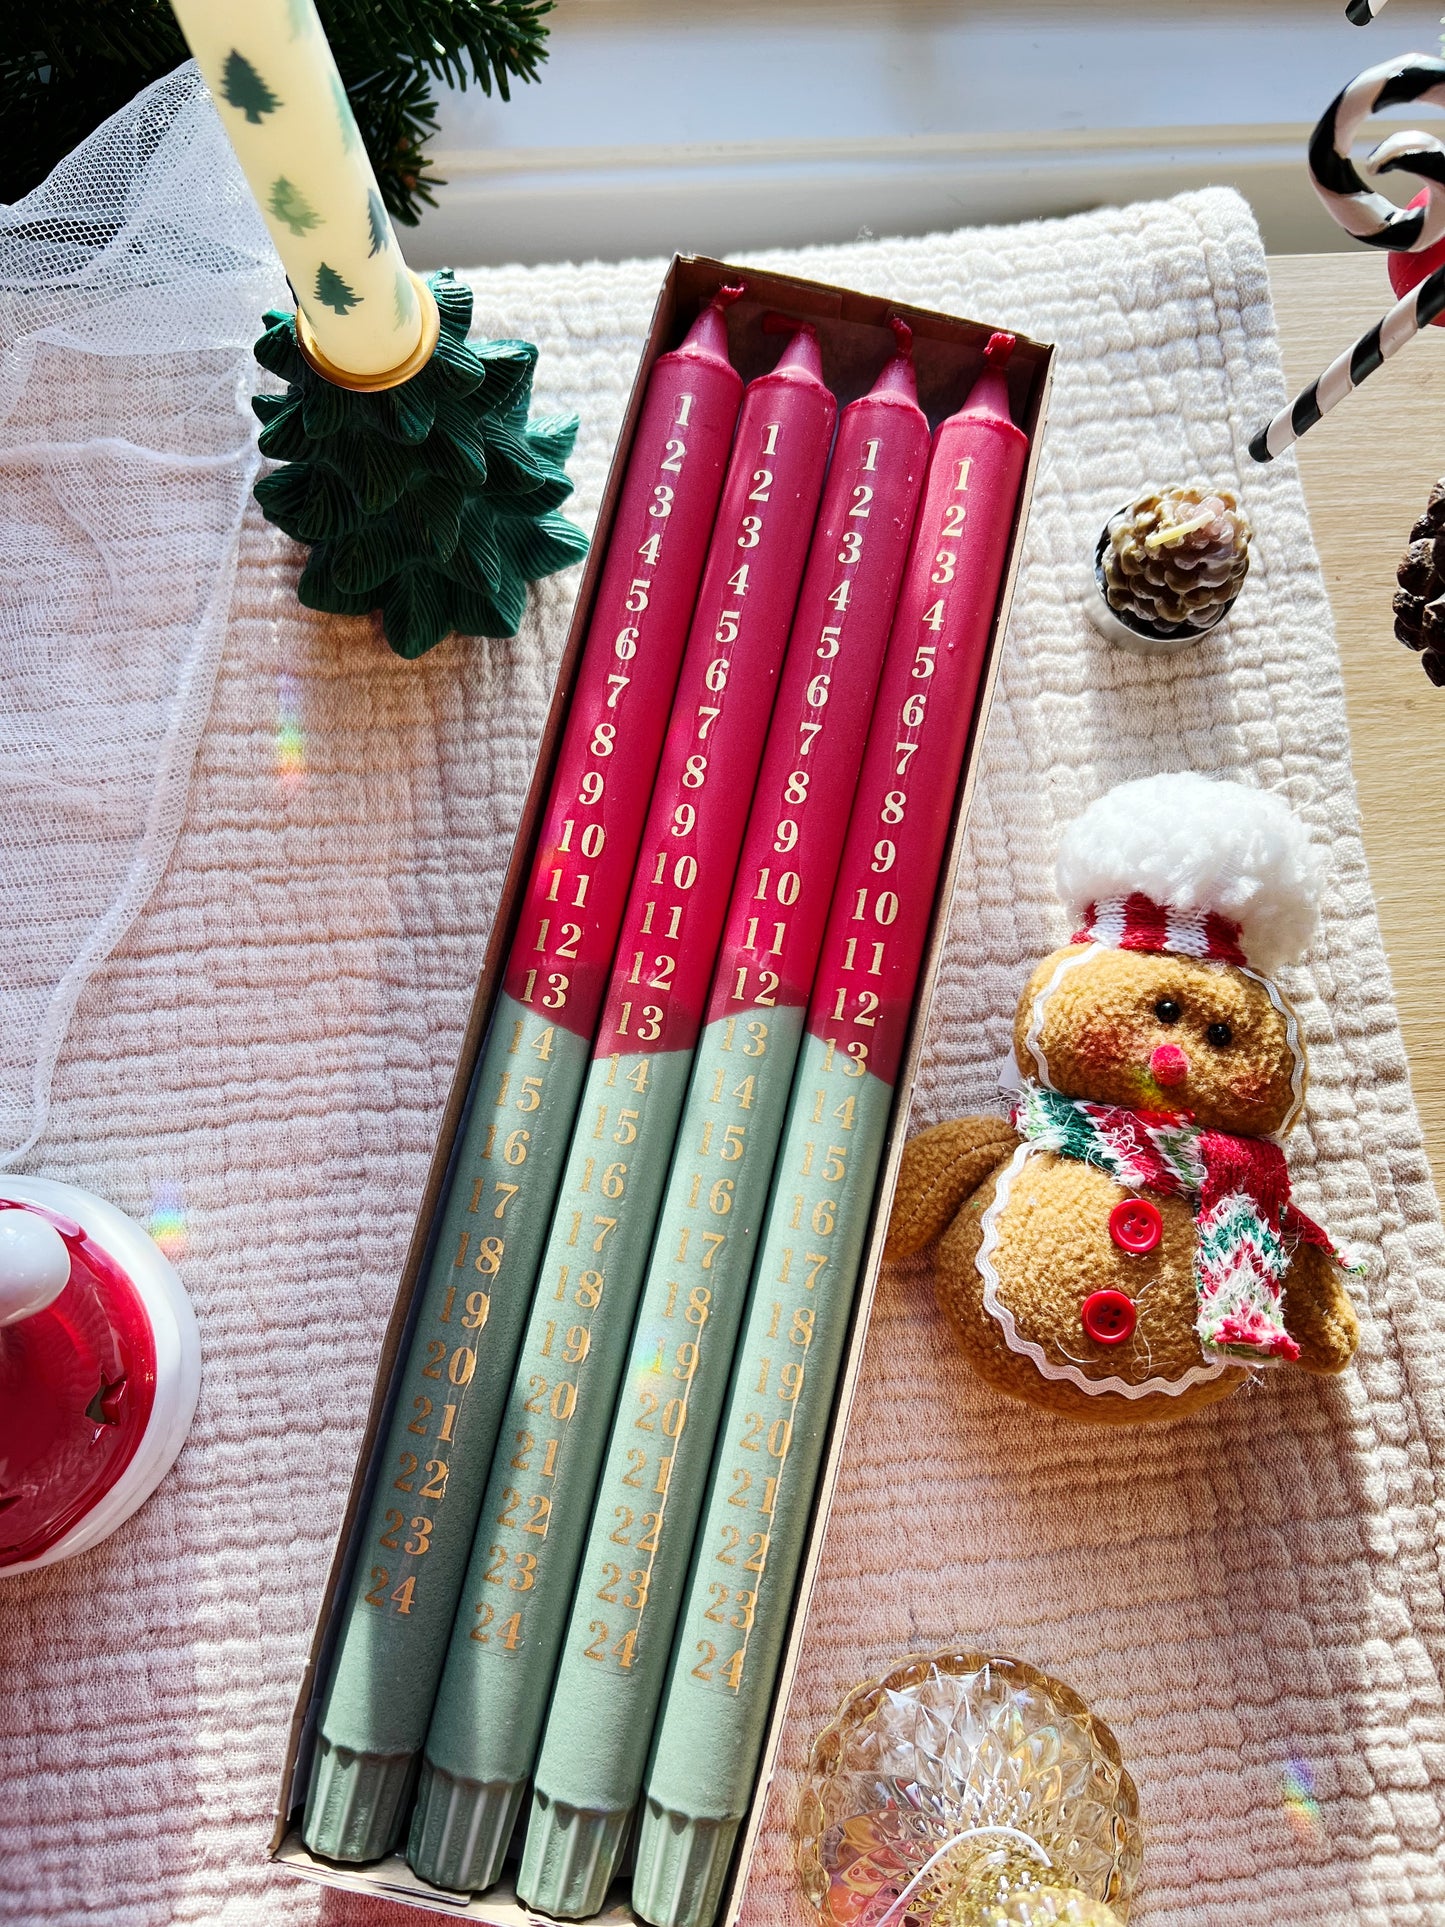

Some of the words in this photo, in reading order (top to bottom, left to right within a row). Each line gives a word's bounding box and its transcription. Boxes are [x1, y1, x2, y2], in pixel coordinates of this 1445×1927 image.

[676, 393, 692, 427] 1
[660, 439, 686, 473] 2
[762, 423, 780, 456] 1
[863, 439, 881, 472] 1
[748, 469, 773, 502] 2
[954, 459, 972, 491] 1
[648, 485, 674, 518] 3
[848, 485, 874, 518] 2
[941, 505, 965, 537] 2
[638, 533, 661, 566] 4
[737, 516, 763, 548] 3
[837, 531, 863, 564] 3
[727, 564, 750, 596] 4
[931, 551, 956, 584] 3
[625, 578, 651, 612] 5
[827, 579, 851, 612] 4
[715, 610, 740, 643] 5
[922, 599, 945, 631] 4
[615, 627, 640, 661] 6
[816, 626, 842, 659] 5
[705, 658, 730, 693] 6
[911, 646, 937, 679] 5
[607, 673, 630, 708] 7
[806, 674, 831, 707] 6
[698, 706, 721, 740] 7
[902, 694, 927, 727] 6
[590, 723, 616, 757] 8
[799, 721, 823, 756] 7
[895, 741, 918, 775] 7
[578, 771, 604, 805] 9
[682, 754, 708, 788] 8
[784, 770, 810, 805] 8
[671, 803, 696, 837] 9
[881, 790, 907, 824] 8
[556, 819, 606, 858] 10
[773, 819, 799, 853] 9
[651, 852, 698, 890] 10
[871, 839, 896, 873] 9
[545, 867, 590, 908] 11
[753, 867, 801, 906] 10
[640, 901, 683, 940] 11
[851, 888, 899, 926] 10
[532, 918, 582, 959] 12
[742, 917, 786, 956] 11
[627, 951, 676, 991] 12
[841, 937, 885, 976] 11
[519, 969, 569, 1009] 13
[731, 966, 779, 1007] 12
[615, 1001, 664, 1041] 13
[830, 987, 879, 1027] 12
[508, 1021, 554, 1060] 14
[721, 1018, 768, 1056] 13
[605, 1053, 648, 1093] 14
[821, 1039, 868, 1077] 13
[496, 1073, 542, 1111] 15
[710, 1068, 755, 1109] 14
[593, 1105, 639, 1145] 15
[810, 1090, 855, 1129] 14
[482, 1125, 529, 1164] 16
[698, 1121, 745, 1161] 15
[580, 1158, 627, 1198] 16
[800, 1142, 846, 1181] 15
[468, 1179, 518, 1218] 17
[688, 1174, 734, 1214] 16
[567, 1211, 617, 1251] 17
[790, 1194, 836, 1235] 16
[455, 1233, 503, 1273] 18
[676, 1228, 725, 1268] 17
[554, 1265, 602, 1307] 18
[777, 1248, 827, 1289] 17
[441, 1287, 489, 1327] 19
[664, 1282, 711, 1324] 18
[541, 1320, 590, 1362] 19
[767, 1302, 814, 1344] 18
[423, 1341, 475, 1384] 20
[650, 1338, 698, 1379] 19
[524, 1375, 577, 1419] 20
[755, 1358, 803, 1400] 19
[408, 1396, 457, 1441] 21
[635, 1392, 686, 1436] 20
[511, 1431, 558, 1476] 21
[740, 1413, 791, 1457] 20
[394, 1453, 448, 1498] 22
[622, 1449, 671, 1494] 21
[728, 1469, 776, 1514] 21
[497, 1488, 551, 1535] 22
[610, 1506, 662, 1551] 22
[380, 1509, 433, 1554] 23
[716, 1525, 769, 1572] 22
[484, 1545, 536, 1591] 23
[597, 1563, 648, 1608] 23
[366, 1566, 416, 1613] 24
[705, 1583, 756, 1629] 23
[470, 1603, 521, 1649] 24
[584, 1621, 636, 1667] 24
[691, 1640, 743, 1687] 24
